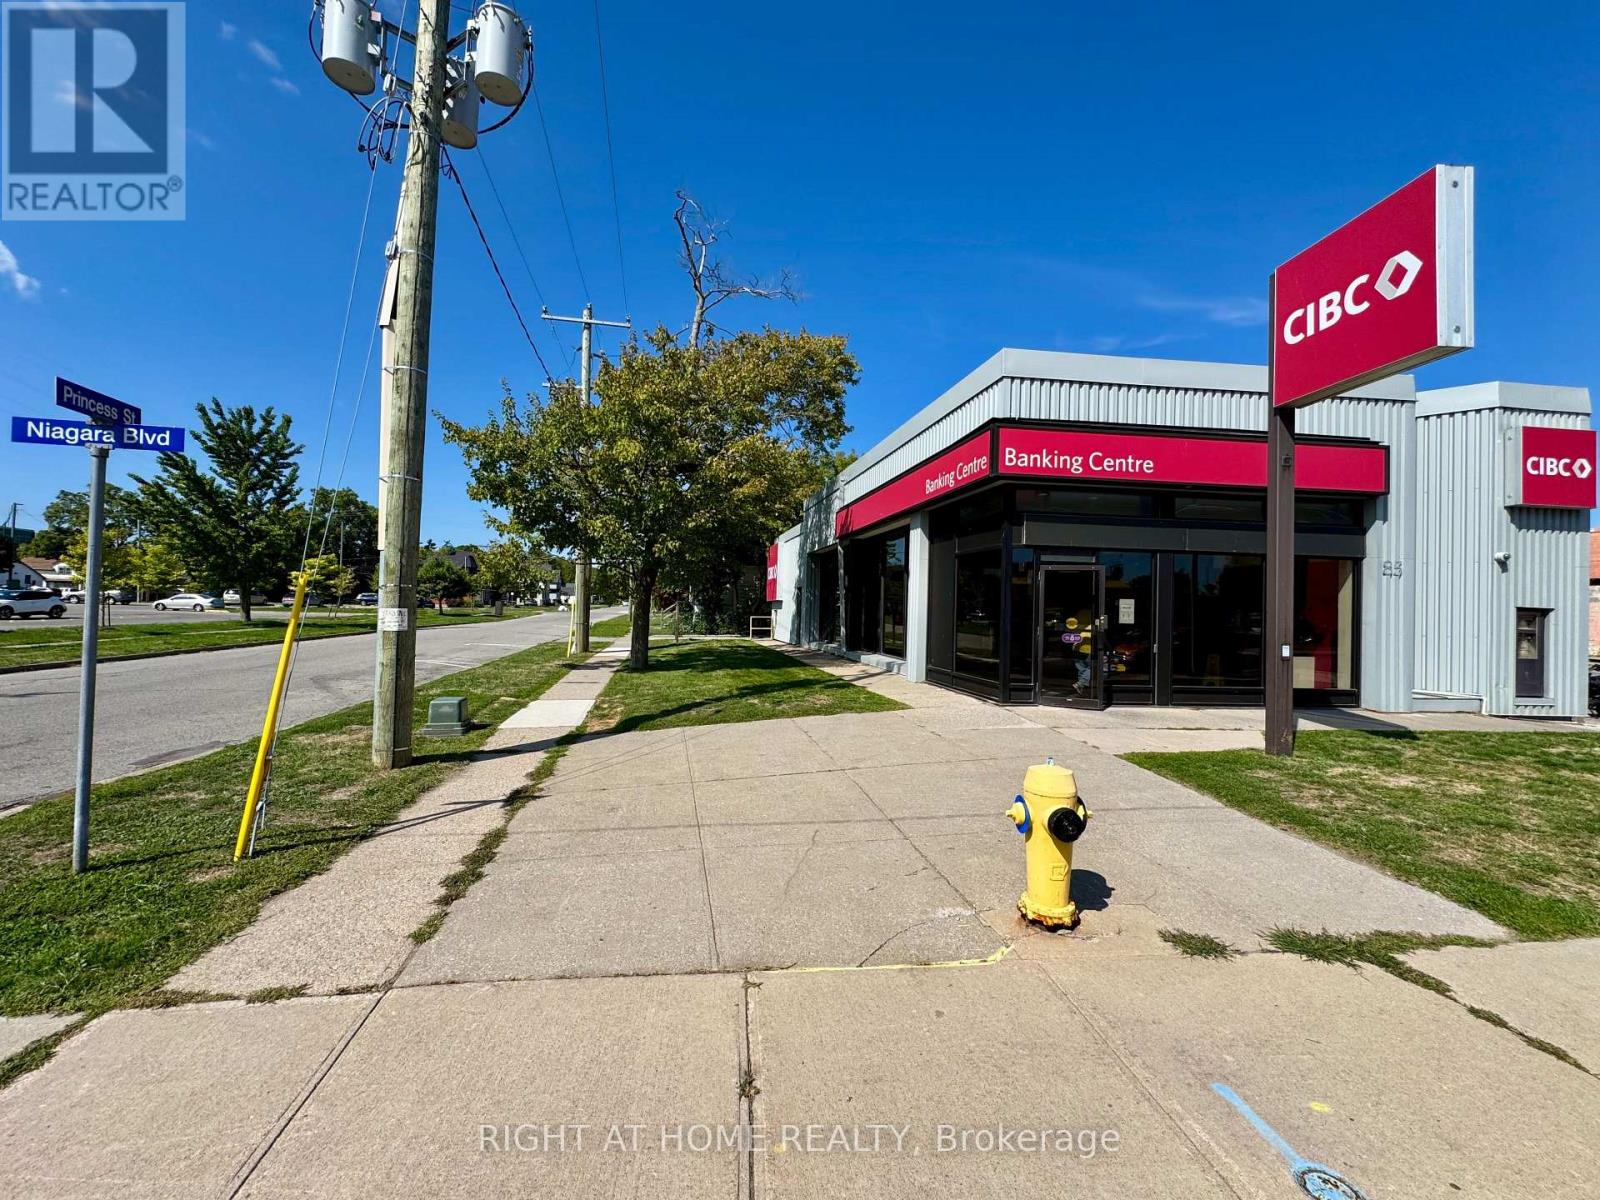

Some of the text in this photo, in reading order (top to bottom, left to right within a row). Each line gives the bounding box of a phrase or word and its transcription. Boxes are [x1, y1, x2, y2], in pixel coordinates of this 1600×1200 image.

[1283, 273, 1370, 345] CIBC
[63, 385, 136, 424] Princess St
[27, 421, 170, 446] Niagara Blvd
[925, 454, 987, 494] Banking Centre
[1004, 448, 1154, 474] Banking Centre
[1526, 456, 1571, 477] CIBC
